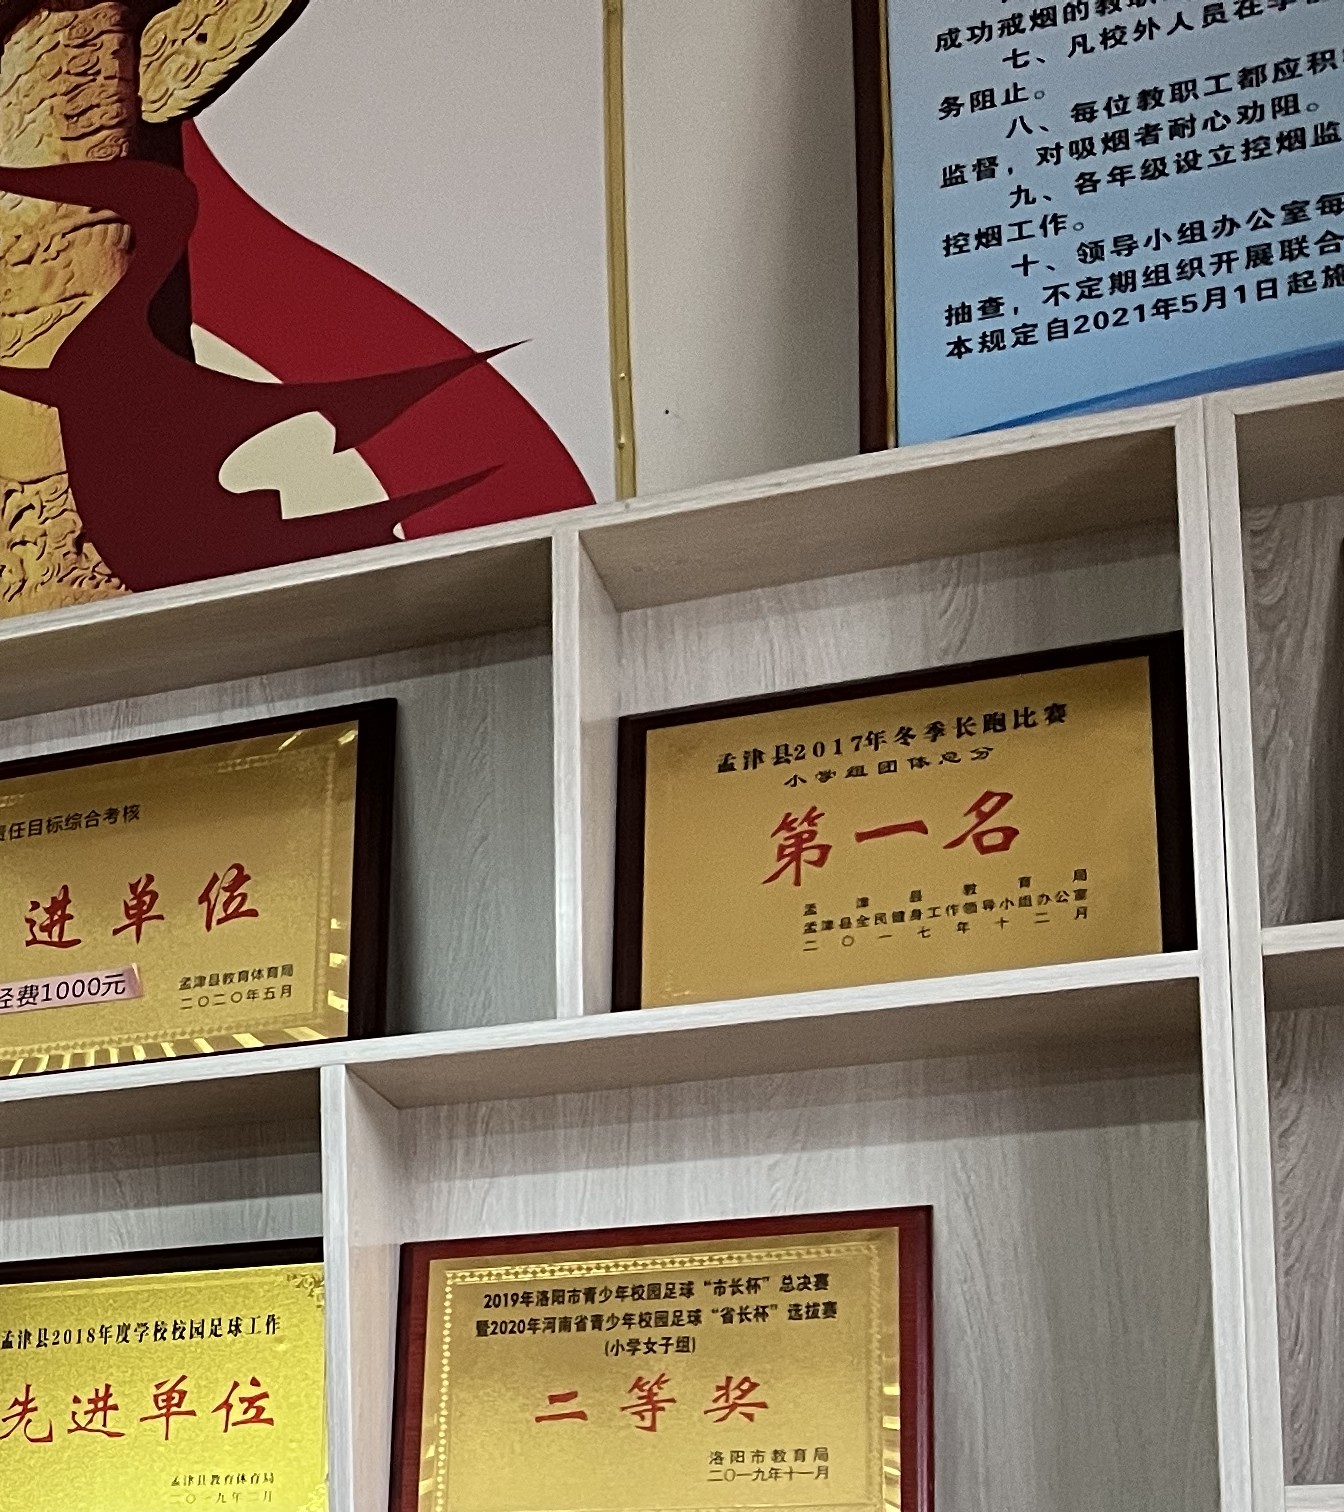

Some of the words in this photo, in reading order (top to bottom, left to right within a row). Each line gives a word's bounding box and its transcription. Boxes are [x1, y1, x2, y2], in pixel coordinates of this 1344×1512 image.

[935, 0, 1174, 53] 成功戒烟的教
[1002, 0, 1322, 68] 七、凡校外人员在
[938, 82, 1045, 120] 务阻止。
[1006, 47, 1344, 139] 八、每位教职工都应积
[940, 92, 1321, 188] 监督，对吸烟者耐心劝阻。
[942, 212, 1086, 257] 控烟工作。
[1011, 191, 1344, 278] 十、领导小组办公室每
[945, 228, 1344, 326] 抽查，不定期组织开展联合
[946, 266, 1344, 359] 本规定自2021年5月1日起施
[716, 702, 1068, 775] 孟津县2017年冬季长跑比赛
[785, 746, 994, 788] 小学组团体总分
[761, 789, 1020, 887] 第一名
[179, 963, 295, 992] 孟津县教育体育局
[0, 1313, 282, 1351] 孟津县2018年度学校校园足球工作
[535, 1373, 770, 1433] 二等奖
[709, 1447, 830, 1466] 洛阳市教育局
